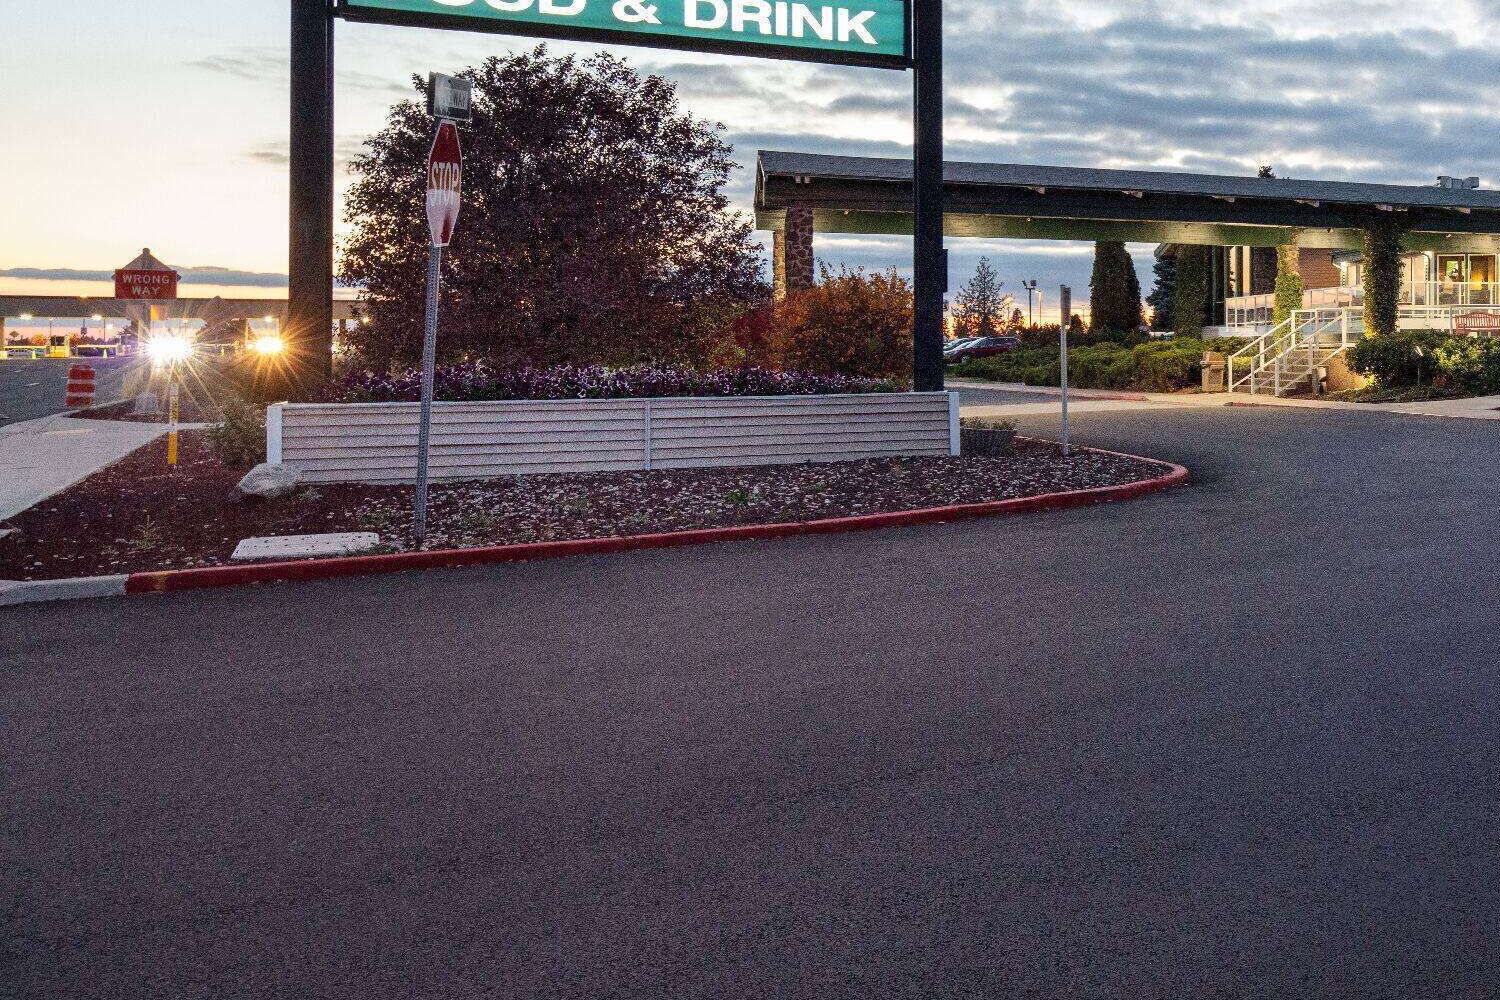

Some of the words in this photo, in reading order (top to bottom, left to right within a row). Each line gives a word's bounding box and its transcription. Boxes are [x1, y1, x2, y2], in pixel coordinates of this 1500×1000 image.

[432, 161, 459, 206] STOP
[123, 274, 170, 284] WRONG
[132, 285, 160, 295] WAY
